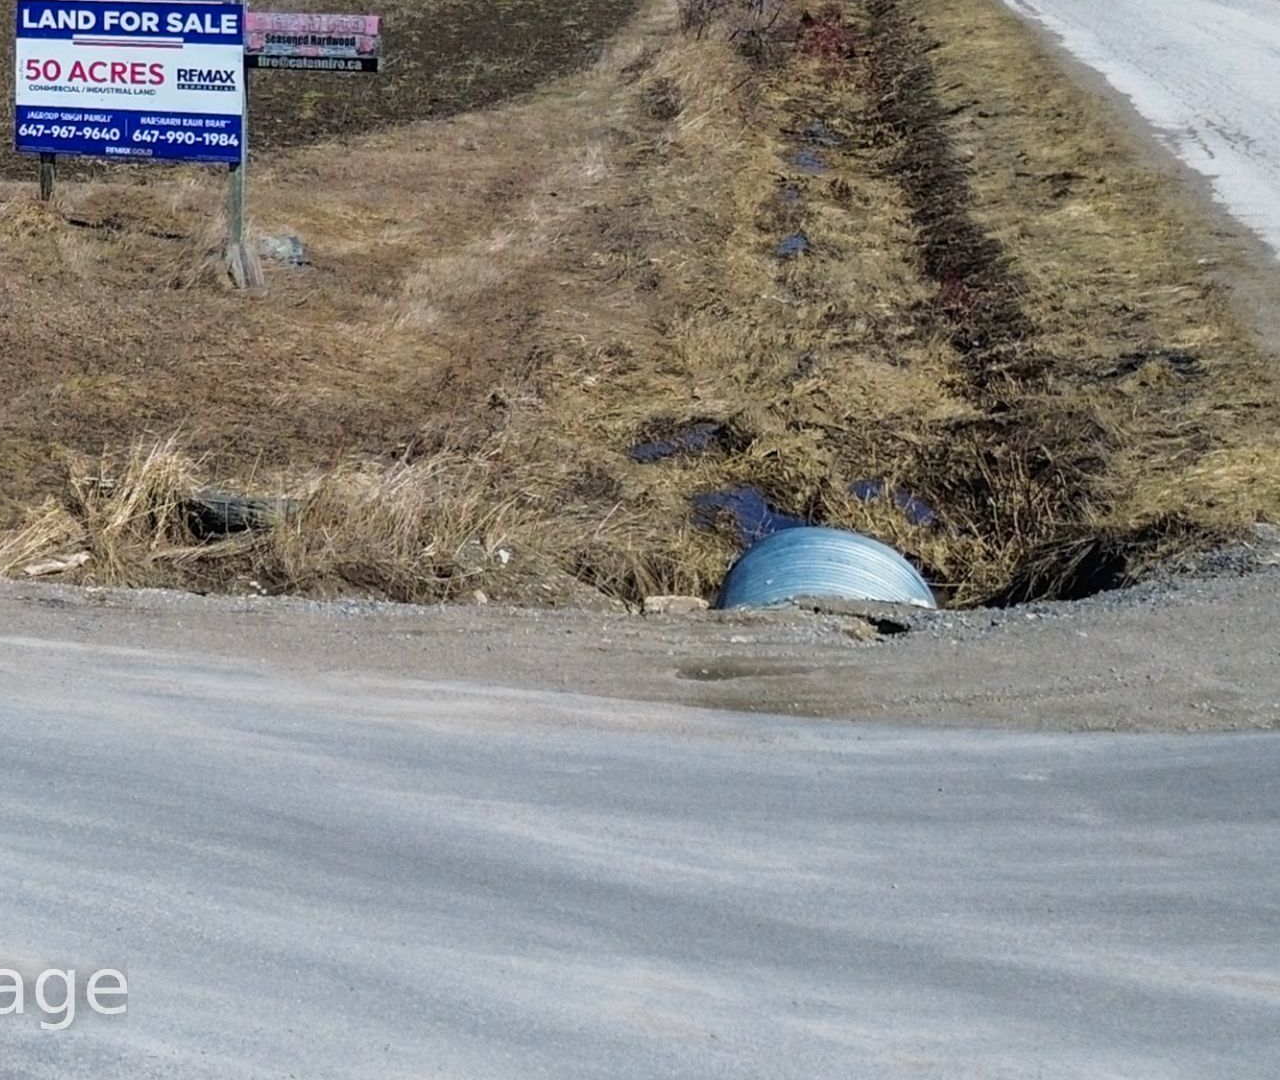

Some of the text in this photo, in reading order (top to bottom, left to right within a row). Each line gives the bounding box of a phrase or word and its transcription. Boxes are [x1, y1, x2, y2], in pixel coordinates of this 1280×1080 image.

[22, 8, 96, 30] LAND
[103, 11, 159, 32] FOR
[166, 12, 238, 35] SALE
[265, 33, 356, 47] Seasoned Hardwood
[25, 58, 61, 82] 50
[67, 60, 165, 86] ACRES
[28, 84, 81, 93] COMMERCIAL
[86, 86, 132, 95] INDUSTRIAL
[133, 88, 157, 96] LAND
[18, 124, 120, 141] 647-967-9640
[132, 129, 239, 147] 647-990-1984
[132, 147, 153, 156] GOLD
